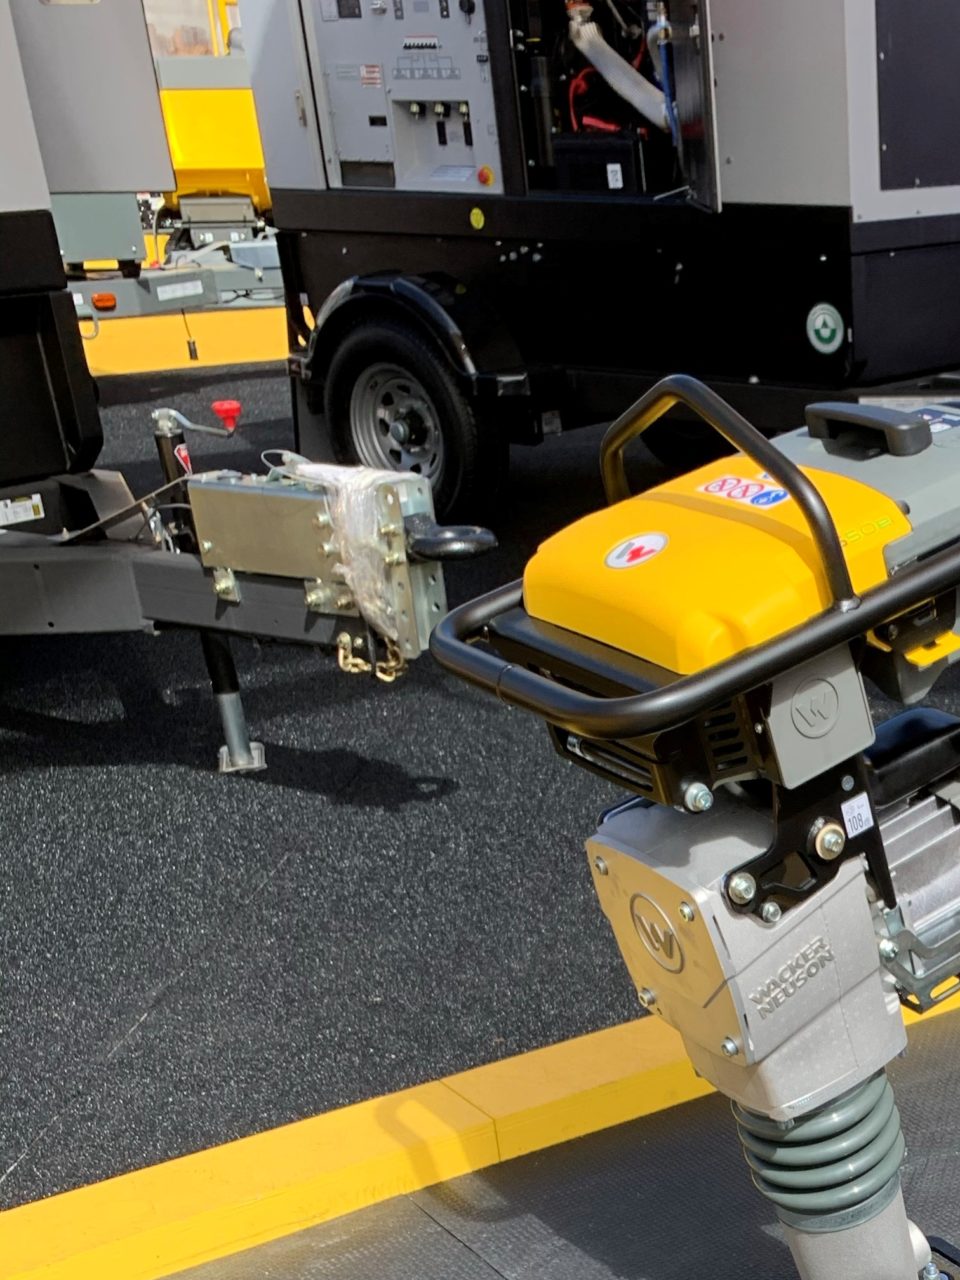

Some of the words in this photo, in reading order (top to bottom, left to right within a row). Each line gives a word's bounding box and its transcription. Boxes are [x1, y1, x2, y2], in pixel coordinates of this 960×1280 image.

[848, 812, 864, 833] 108
[748, 935, 828, 1004] WACKER
[757, 944, 835, 1020] NEUSON
